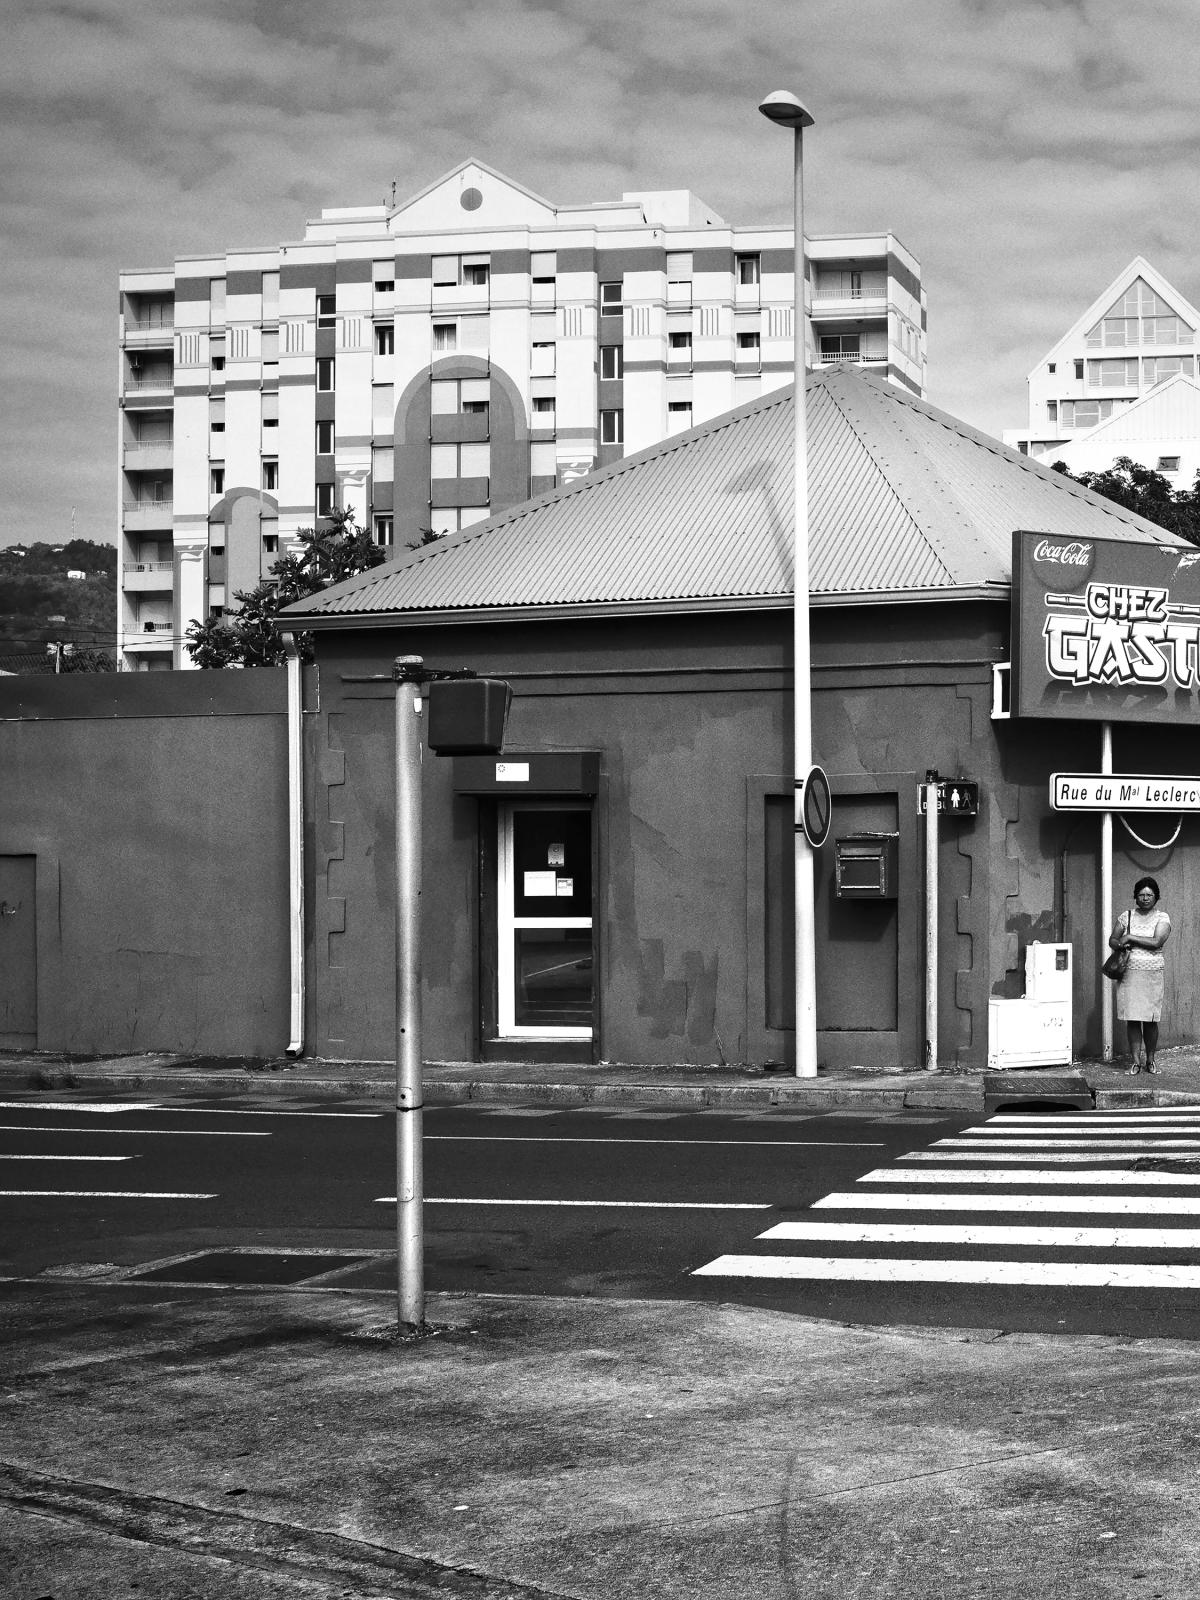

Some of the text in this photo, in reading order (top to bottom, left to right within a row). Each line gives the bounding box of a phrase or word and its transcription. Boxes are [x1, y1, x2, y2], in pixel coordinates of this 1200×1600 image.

[1033, 539, 1093, 566] Coca-Cola
[1088, 583, 1167, 622] CHEZ
[1061, 784, 1088, 801] Rue
[1095, 785, 1112, 801] du
[1145, 786, 1196, 803] Leclerc
